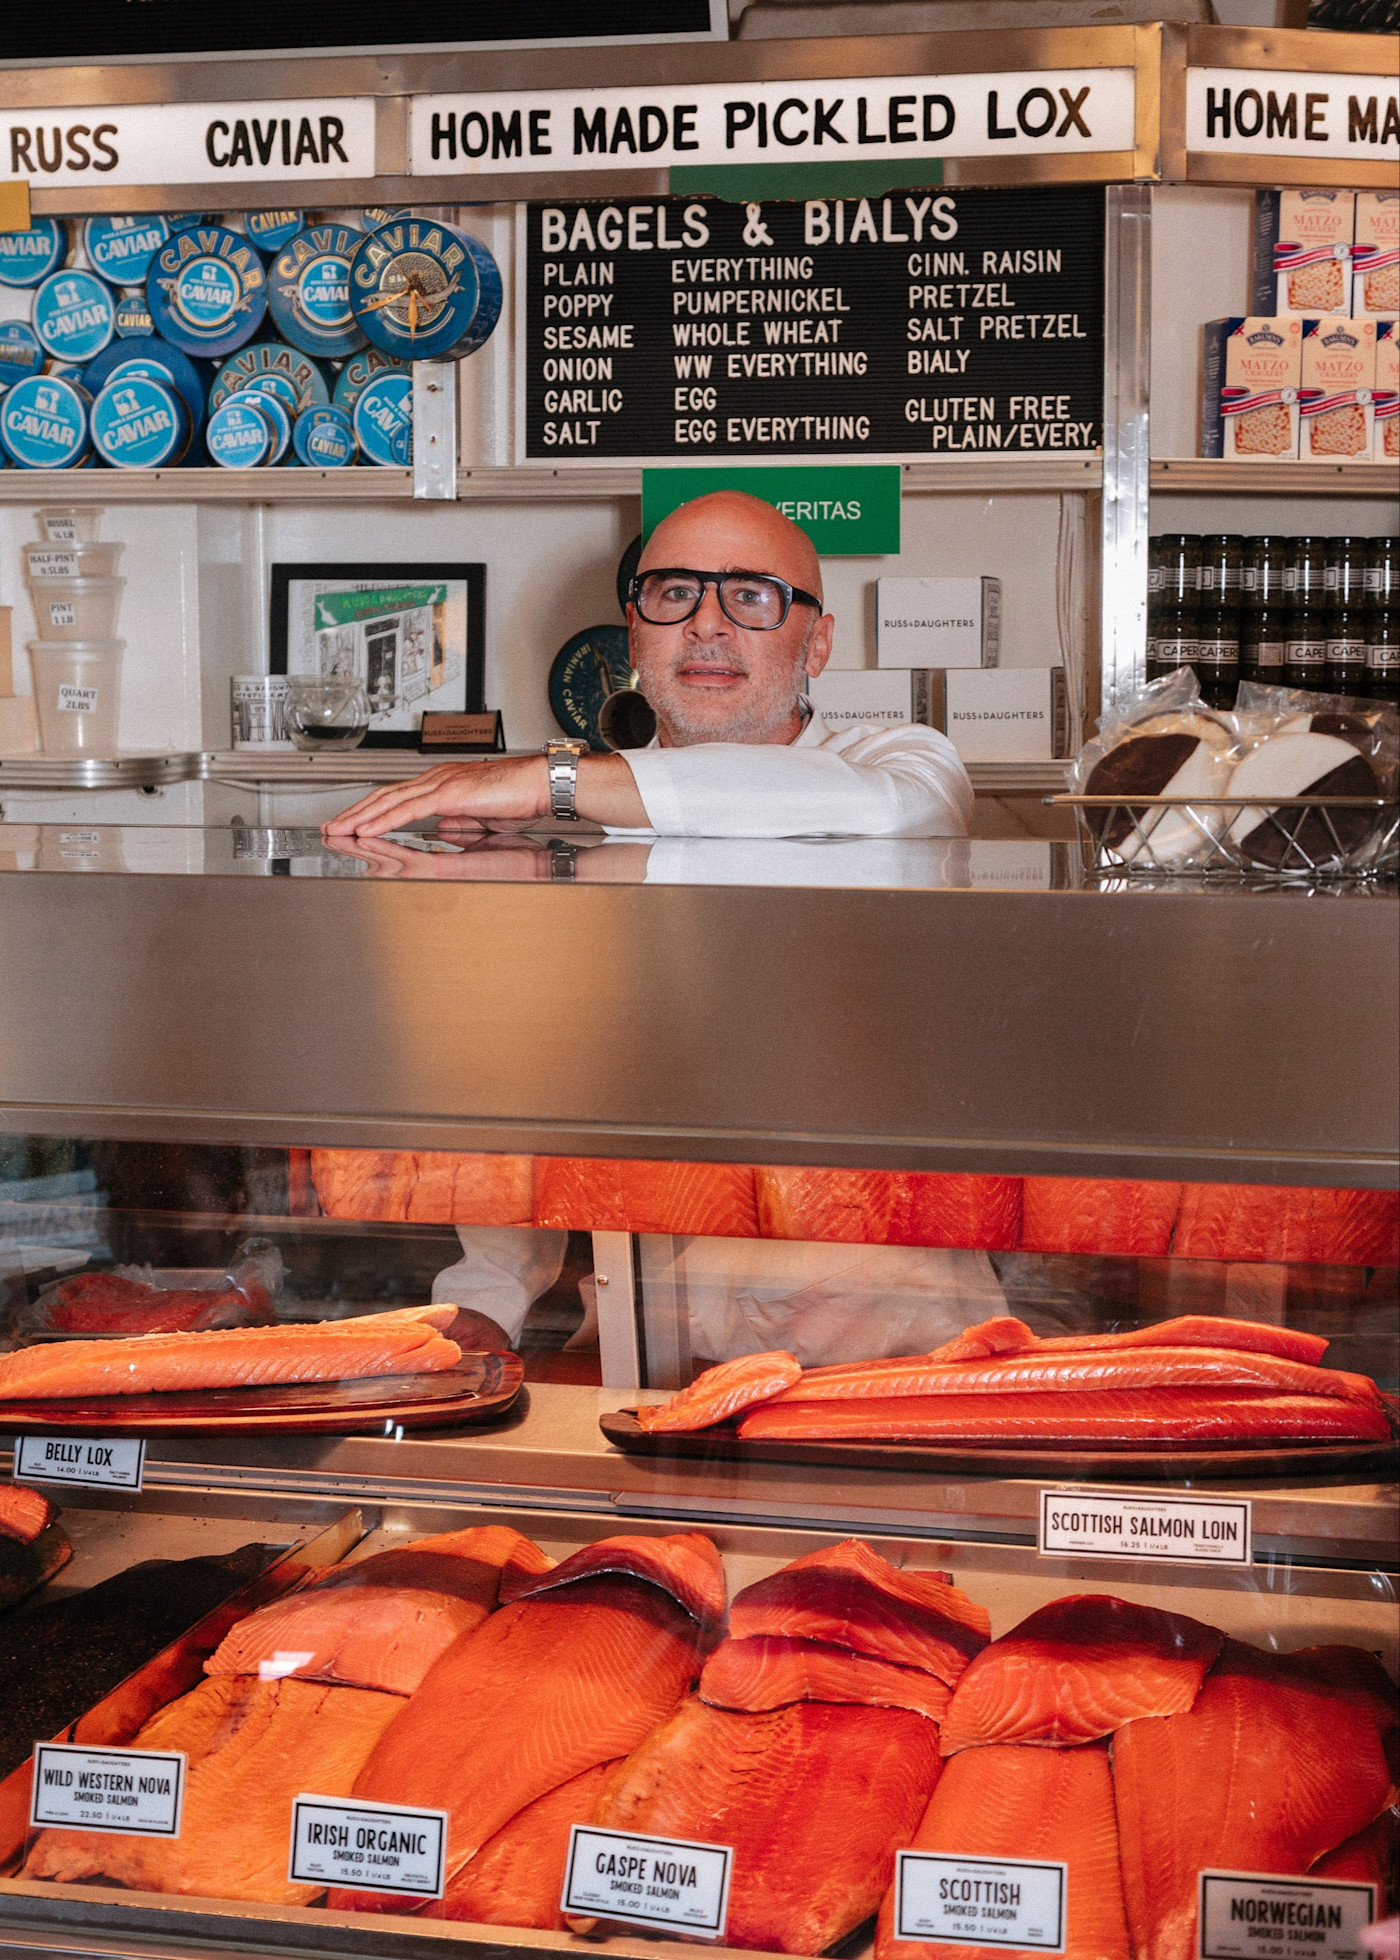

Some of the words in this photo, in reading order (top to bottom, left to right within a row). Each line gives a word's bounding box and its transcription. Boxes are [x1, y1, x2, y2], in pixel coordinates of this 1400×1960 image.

[431, 110, 552, 160] HOME
[572, 104, 700, 155] MADE
[724, 95, 957, 150] PICKLED
[987, 86, 1092, 139] LOX
[1207, 87, 1329, 142] HOME
[1348, 95, 1400, 145] MA
[11, 125, 119, 173] RUSS
[206, 116, 349, 168] CAVIAR
[542, 204, 710, 252] BAGELS
[742, 203, 774, 247] &
[805, 197, 958, 245] BIALYS
[1293, 214, 1342, 227] MATZO
[1369, 216, 1398, 228] MAT
[0, 236, 51, 256] AVIAR
[94, 230, 162, 262] CAVIAR
[354, 223, 465, 288] CAVIAR
[159, 230, 263, 294] CAVIAR
[545, 262, 614, 286] PLAIN
[672, 257, 814, 282] EVERYTHING
[907, 253, 970, 277] CINN.
[982, 250, 1061, 275] RAISIN
[181, 283, 233, 305] CAVIAR
[545, 294, 614, 318] POPPY
[674, 288, 850, 314] PUMPERNICKEL
[909, 282, 1015, 309] PRETZEL
[43, 304, 109, 340] CAVIAR
[117, 313, 152, 327] CAVIAR
[906, 316, 964, 342] SALT
[980, 314, 1087, 340] PRETZEL
[544, 325, 634, 350] SESAME
[673, 322, 751, 347] WHOLE
[763, 319, 842, 346] WHEAT
[544, 358, 612, 381] ONION
[674, 355, 713, 379] WW
[727, 352, 868, 377] EVERYTHING
[907, 350, 971, 374] BIALY
[1240, 359, 1289, 371] MATZO
[1315, 361, 1364, 372] MATZO
[212, 347, 314, 408] CAVIAR
[544, 389, 623, 414] GARLIC
[674, 387, 717, 411] EGG
[905, 398, 995, 422] GLUTEN
[1010, 396, 1071, 420] FREE
[7, 410, 76, 448] CAVIAR
[102, 410, 172, 451] CAVIAR
[211, 428, 263, 450] CAVIAR
[543, 421, 601, 445] SALT
[675, 419, 717, 443] EGG
[727, 416, 870, 441] EVERYTHING
[932, 423, 1097, 450] PLAIN/EVERY.
[311, 437, 347, 457] CAVIAR
[30, 554, 75, 563] HALF-PINT
[50, 603, 73, 612] PINT
[62, 615, 74, 623] LB
[562, 643, 592, 684] IRANIAN
[1163, 646, 1199, 657] CAPER
[1295, 647, 1324, 658] CAPE
[61, 687, 97, 699] QUART
[562, 688, 588, 730] CAVIAR
[821, 710, 904, 720] USS&DAUGHTERS
[45, 1442, 83, 1463] BELLY
[87, 1447, 114, 1466] LOX
[57, 1466, 76, 1474] 14.00
[1052, 1511, 1123, 1535] SCOTTISH
[1130, 1516, 1195, 1539] SALMON
[1202, 1520, 1238, 1541] LOIN
[1120, 1541, 1141, 1549] 16.25
[44, 1768, 73, 1787] WILD
[78, 1771, 134, 1792] WESTERN
[138, 1776, 171, 1795] NOVA
[73, 1791, 104, 1804] SMOKED
[107, 1794, 139, 1806] SALMON
[79, 1811, 102, 1819] 22.50
[307, 1822, 349, 1847] IRISH
[356, 1828, 428, 1855] ORGANIC
[332, 1850, 364, 1864] SMOKED
[367, 1853, 400, 1867] SALMON
[595, 1852, 647, 1880] GASPE
[653, 1860, 698, 1888] NOVA
[340, 1868, 362, 1877] 15.50
[610, 1880, 643, 1894] SMOKED
[646, 1885, 680, 1900] SALMON
[939, 1878, 1021, 1906] SCOTTISH
[616, 1898, 640, 1909] 15.00
[943, 1904, 978, 1918] SMOKED
[981, 1907, 1017, 1921] SALMON
[1230, 1898, 1342, 1929] NORWEGIAN
[952, 1923, 976, 1932] 15.50
[1247, 1926, 1285, 1941] SMOKED
[1287, 1929, 1326, 1942] SALMON
